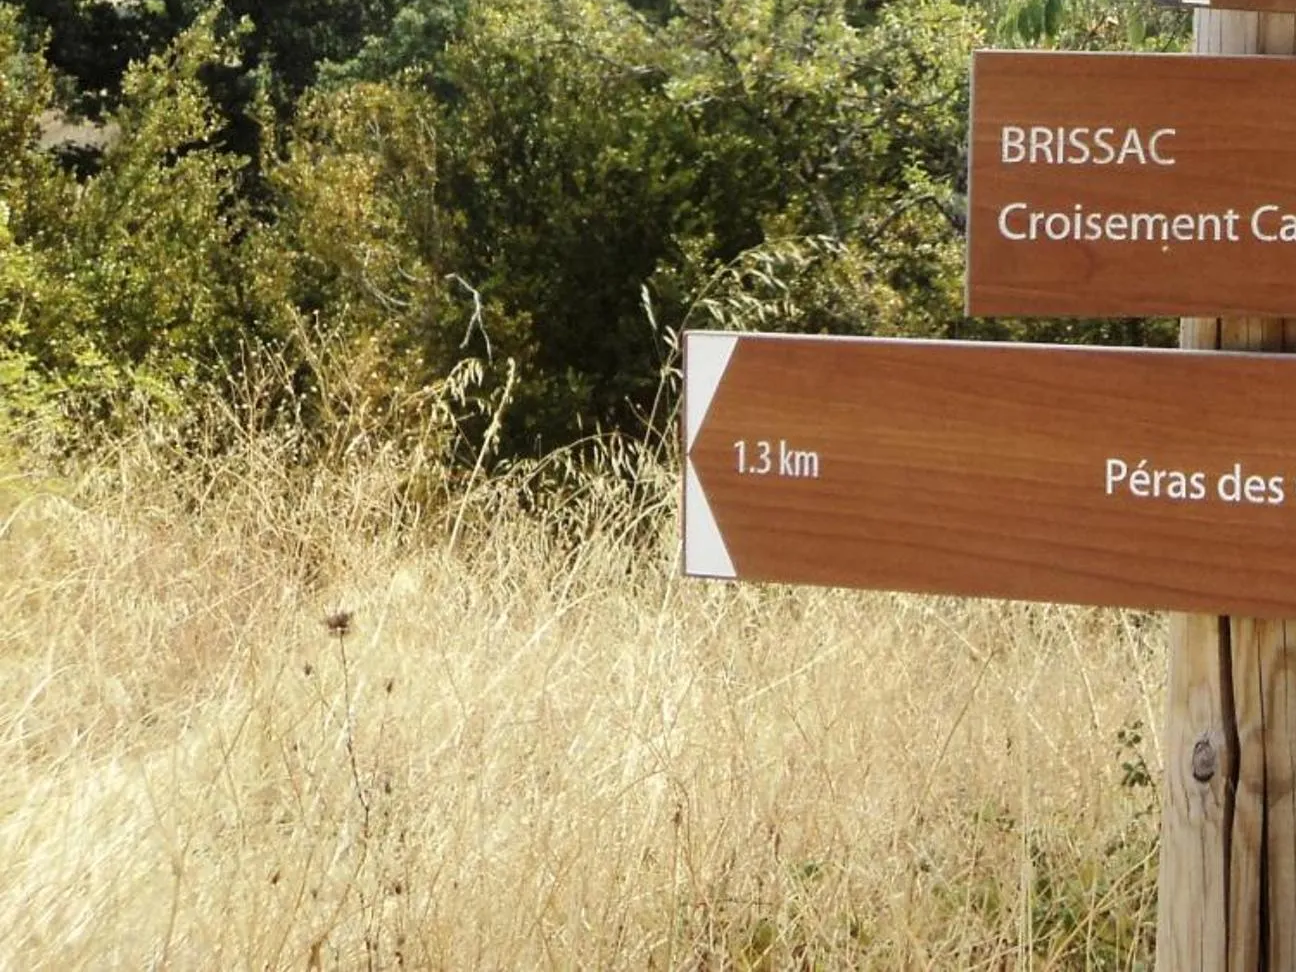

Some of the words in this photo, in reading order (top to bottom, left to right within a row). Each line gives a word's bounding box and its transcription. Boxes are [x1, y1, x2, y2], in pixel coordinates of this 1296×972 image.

[1000, 126, 1176, 166] BRISSAC
[998, 202, 1239, 241] Croisement
[733, 440, 772, 474] 1.3
[779, 439, 819, 478] km
[1105, 458, 1206, 501] Péras
[1217, 464, 1285, 505] des
